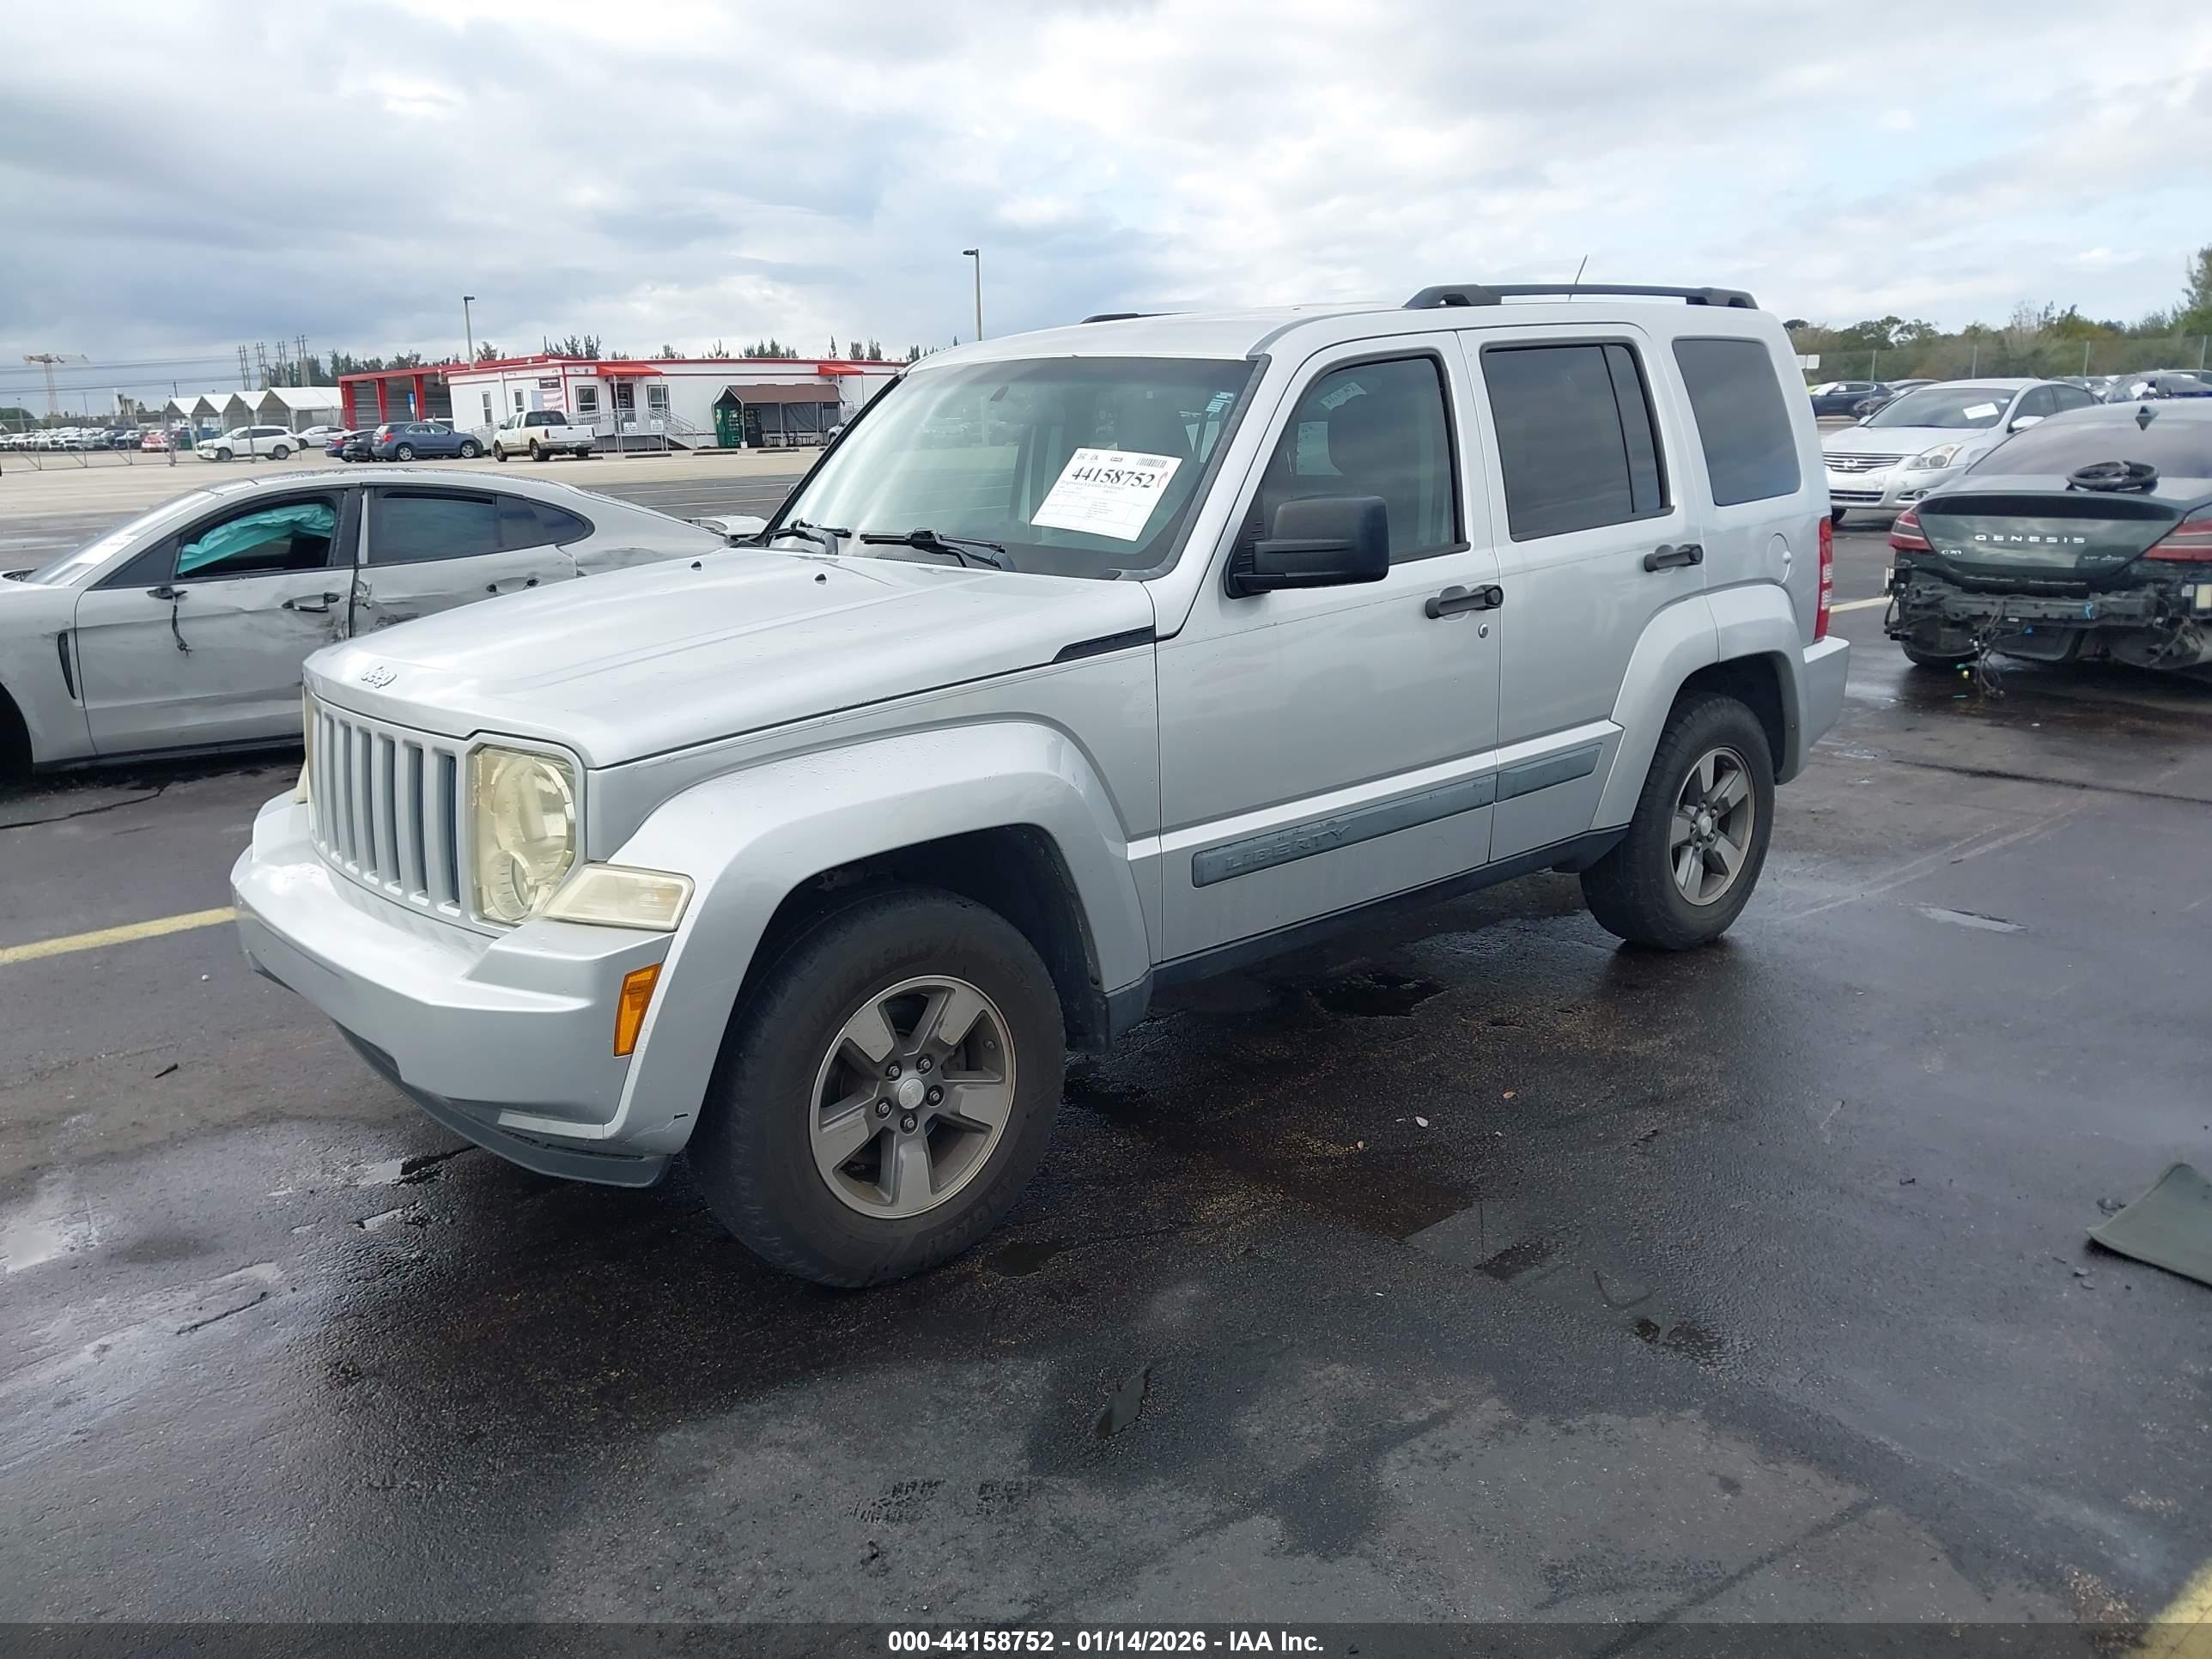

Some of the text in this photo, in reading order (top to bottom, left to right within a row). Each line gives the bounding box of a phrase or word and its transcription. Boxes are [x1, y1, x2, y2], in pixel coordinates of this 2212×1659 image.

[1072, 466, 1155, 488] 44158752
[1975, 534, 2086, 544] GENESIS
[360, 665, 398, 690] Jeep
[1226, 825, 1351, 871] LIBERTY
